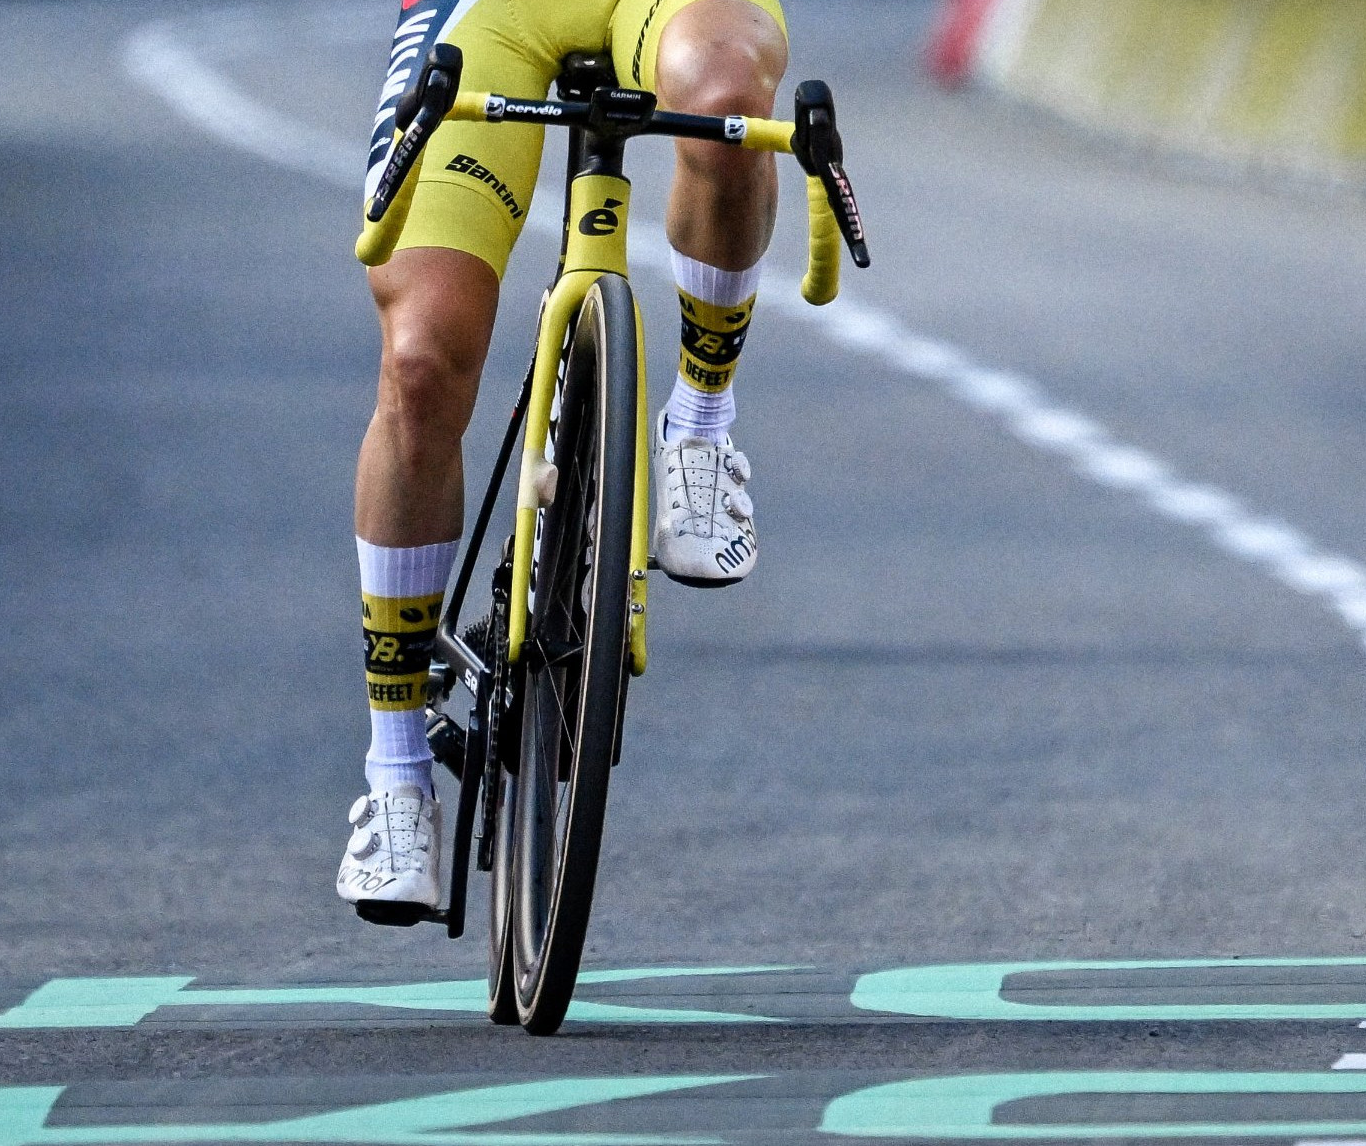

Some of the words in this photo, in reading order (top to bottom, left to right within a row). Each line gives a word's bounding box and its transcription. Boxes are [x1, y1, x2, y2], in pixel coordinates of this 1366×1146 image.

[610, 91, 641, 100] GARMIN
[506, 103, 563, 117] cervélo
[444, 153, 525, 221] Santini
[685, 357, 732, 386] DEFEET
[367, 682, 413, 702] DEFEET
